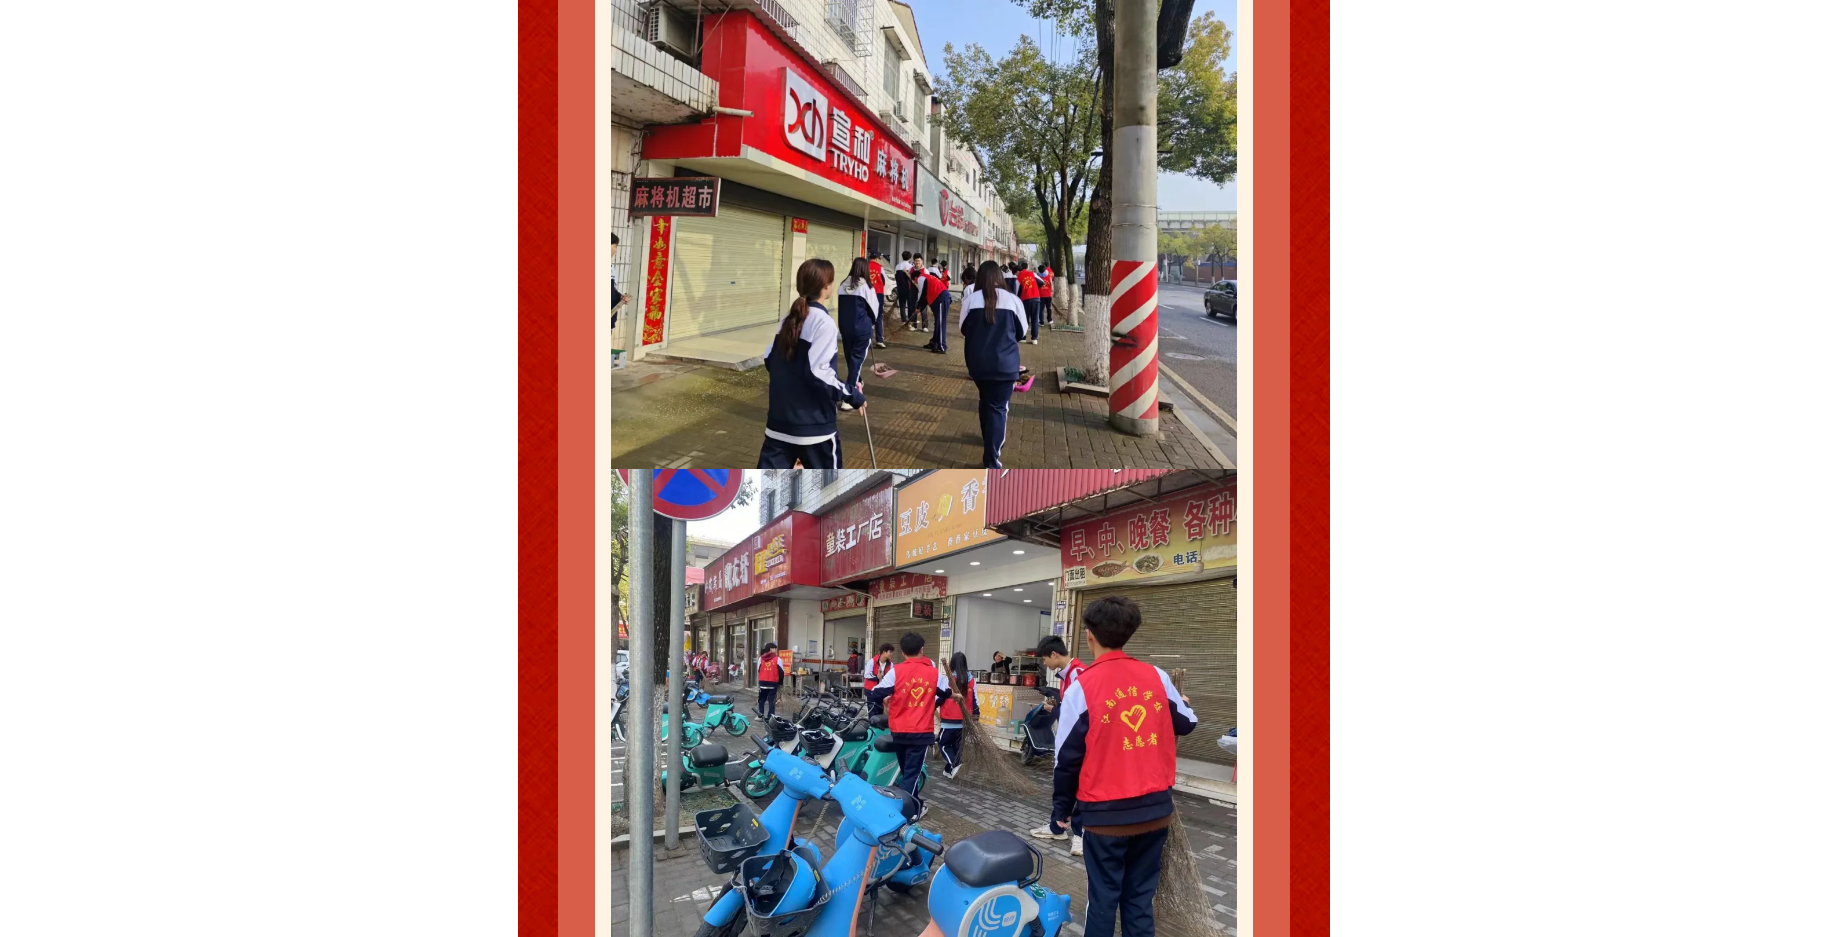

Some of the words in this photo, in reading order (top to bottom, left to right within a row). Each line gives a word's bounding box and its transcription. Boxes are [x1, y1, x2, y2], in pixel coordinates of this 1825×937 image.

[831, 107, 871, 165] 宣和
[829, 148, 869, 183] TRYHO
[876, 149, 909, 191] 麻将机
[634, 185, 713, 209] 麻将机超市
[899, 501, 930, 537] 豆皮
[960, 478, 987, 514] 香
[1070, 508, 1171, 562] 早、中、晚餐
[1182, 491, 1237, 542] 各种
[825, 512, 884, 558] 童装工厂店
[1065, 567, 1086, 582] 门面出租
[1173, 550, 1198, 566] 电话
[1123, 732, 1158, 751] 志愿者
